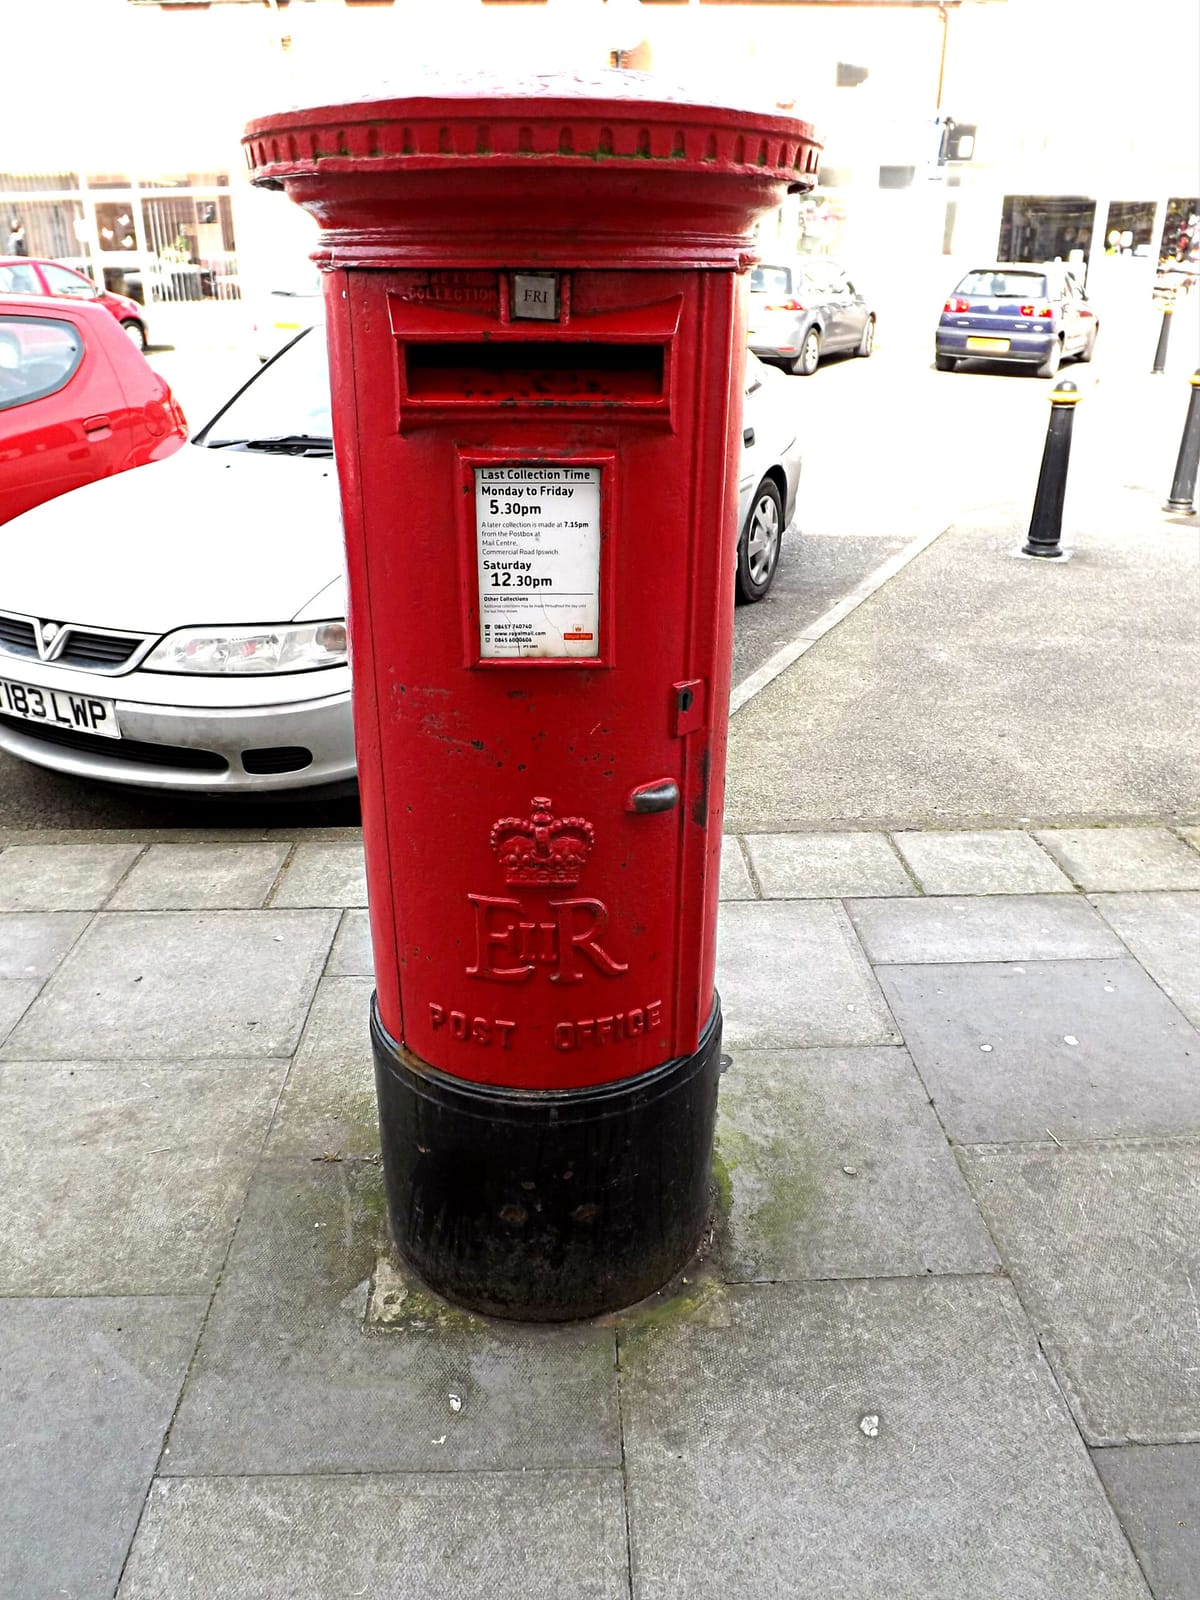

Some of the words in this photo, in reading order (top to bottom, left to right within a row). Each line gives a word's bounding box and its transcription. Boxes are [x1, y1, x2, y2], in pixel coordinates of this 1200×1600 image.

[524, 289, 548, 303] FRI
[481, 470, 505, 480] Last
[507, 470, 561, 480] Collection
[563, 470, 590, 480] Time
[481, 486, 524, 497] Monday
[526, 487, 537, 496] to
[540, 486, 574, 498] Friday
[490, 499, 541, 516] 5.30pm
[564, 521, 589, 529] 7.15pm
[483, 560, 532, 571] Saturday
[491, 572, 552, 589] 12.30pm
[0, 681, 46, 718] 183
[50, 692, 106, 729] LWP
[429, 1002, 516, 1049] POST
[555, 1000, 662, 1049] OFFICE
